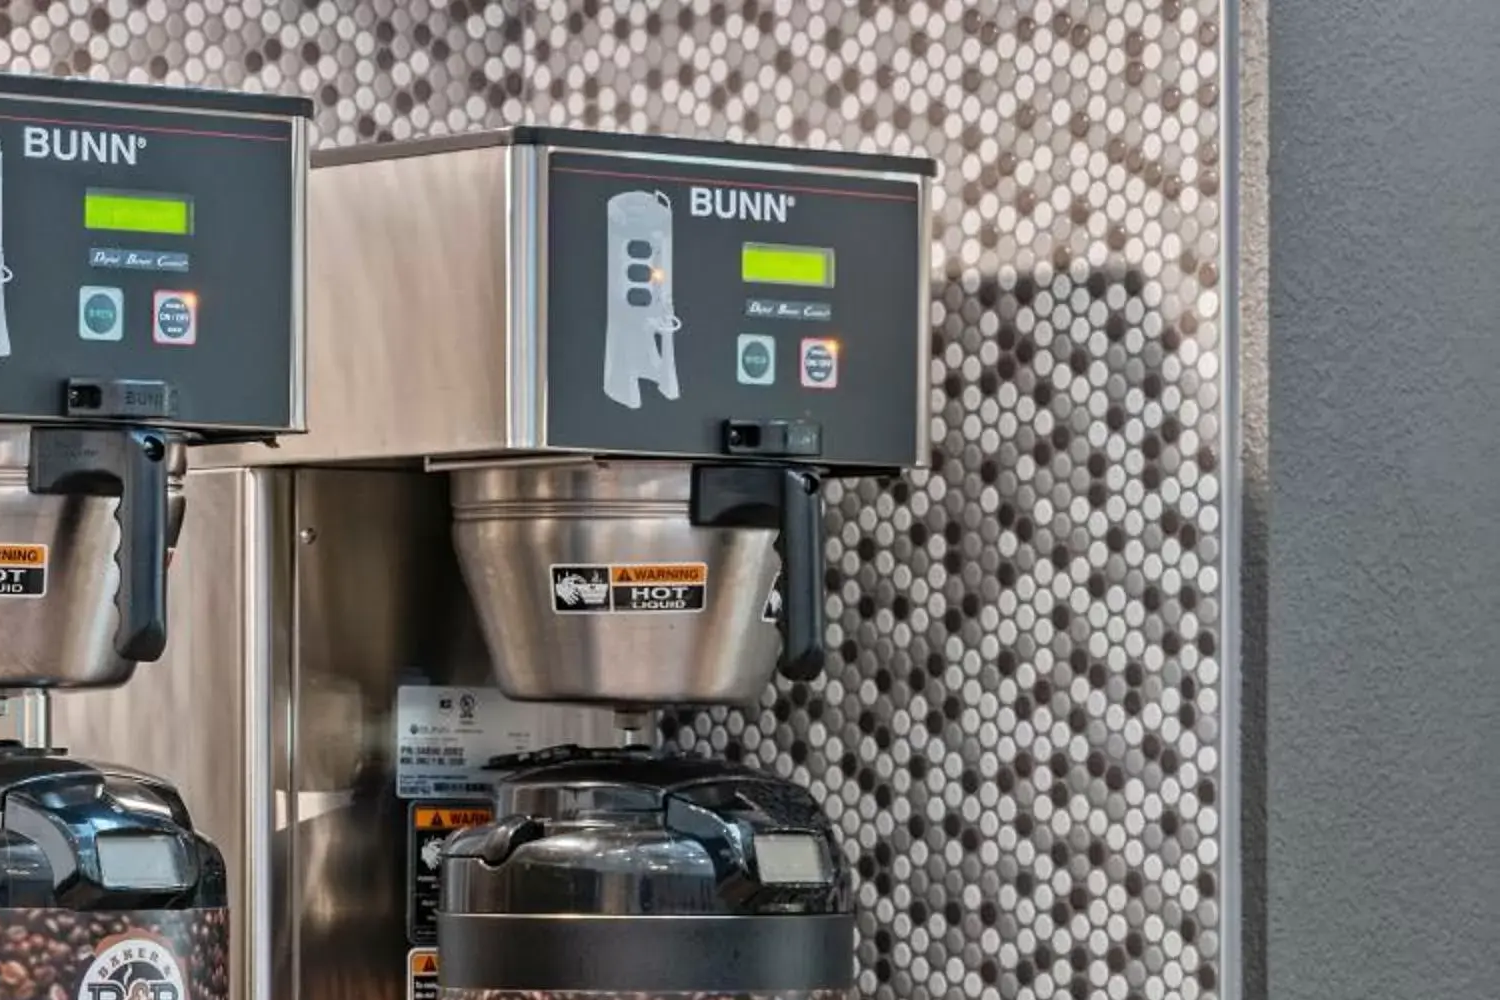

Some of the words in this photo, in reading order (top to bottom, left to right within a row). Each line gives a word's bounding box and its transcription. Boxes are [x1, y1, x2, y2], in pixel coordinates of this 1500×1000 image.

[634, 567, 699, 581] WARNING
[631, 587, 689, 601] HOT
[631, 600, 687, 609] LIQUID
